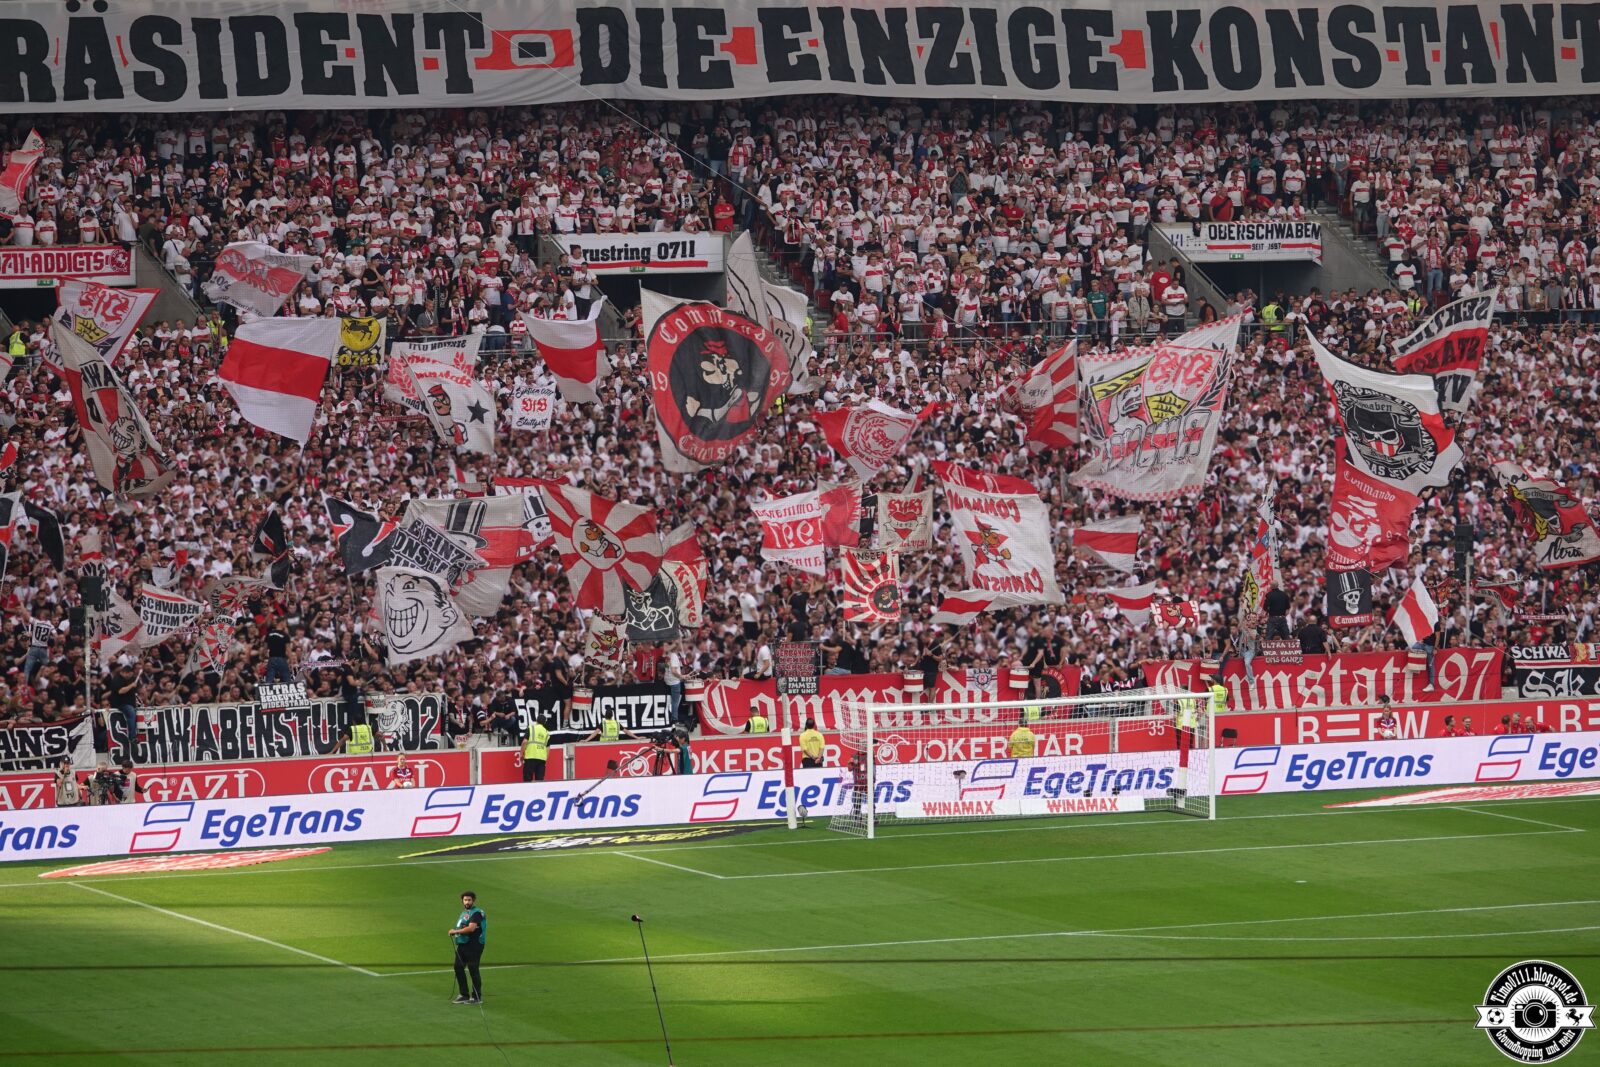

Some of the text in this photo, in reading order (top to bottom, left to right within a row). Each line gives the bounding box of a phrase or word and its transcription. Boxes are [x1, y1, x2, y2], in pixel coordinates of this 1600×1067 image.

[576, 6, 733, 90] DIE
[758, 5, 1119, 92] EINZIGE
[1146, 3, 1600, 93] KONSTANT
[1208, 222, 1322, 241] OBERSCHWABEN
[657, 240, 696, 260] 0711
[1251, 243, 1264, 251] SEIT
[31, 252, 105, 273] ADDICTS
[659, 308, 775, 353] Commando
[337, 353, 378, 366] 0711
[650, 369, 791, 392] 19 97
[1343, 470, 1396, 502] Commando
[673, 564, 699, 623] Kurve
[140, 595, 200, 615] SCHWABEN
[142, 609, 180, 627] STURM
[1334, 614, 1370, 625] Cannstatt
[1510, 645, 1570, 660] SCHWA
[258, 682, 306, 697] ULTRAS
[1154, 651, 1496, 715] Cnnstatt 97
[260, 692, 308, 703] BEDEUTET
[261, 699, 311, 710] WIDERSTAND
[1148, 720, 1166, 737] 35
[910, 733, 1085, 763] JOKERTAR
[1538, 741, 1600, 778] Ege
[1285, 750, 1434, 790] EgeTrans
[1023, 763, 1175, 799] EgeTrans
[480, 790, 642, 832] EgeTrans
[922, 800, 995, 816] WINAMAX
[1046, 797, 1119, 813] WINAMAX
[0, 820, 81, 852] rans
[200, 805, 365, 848] EgeTrans
